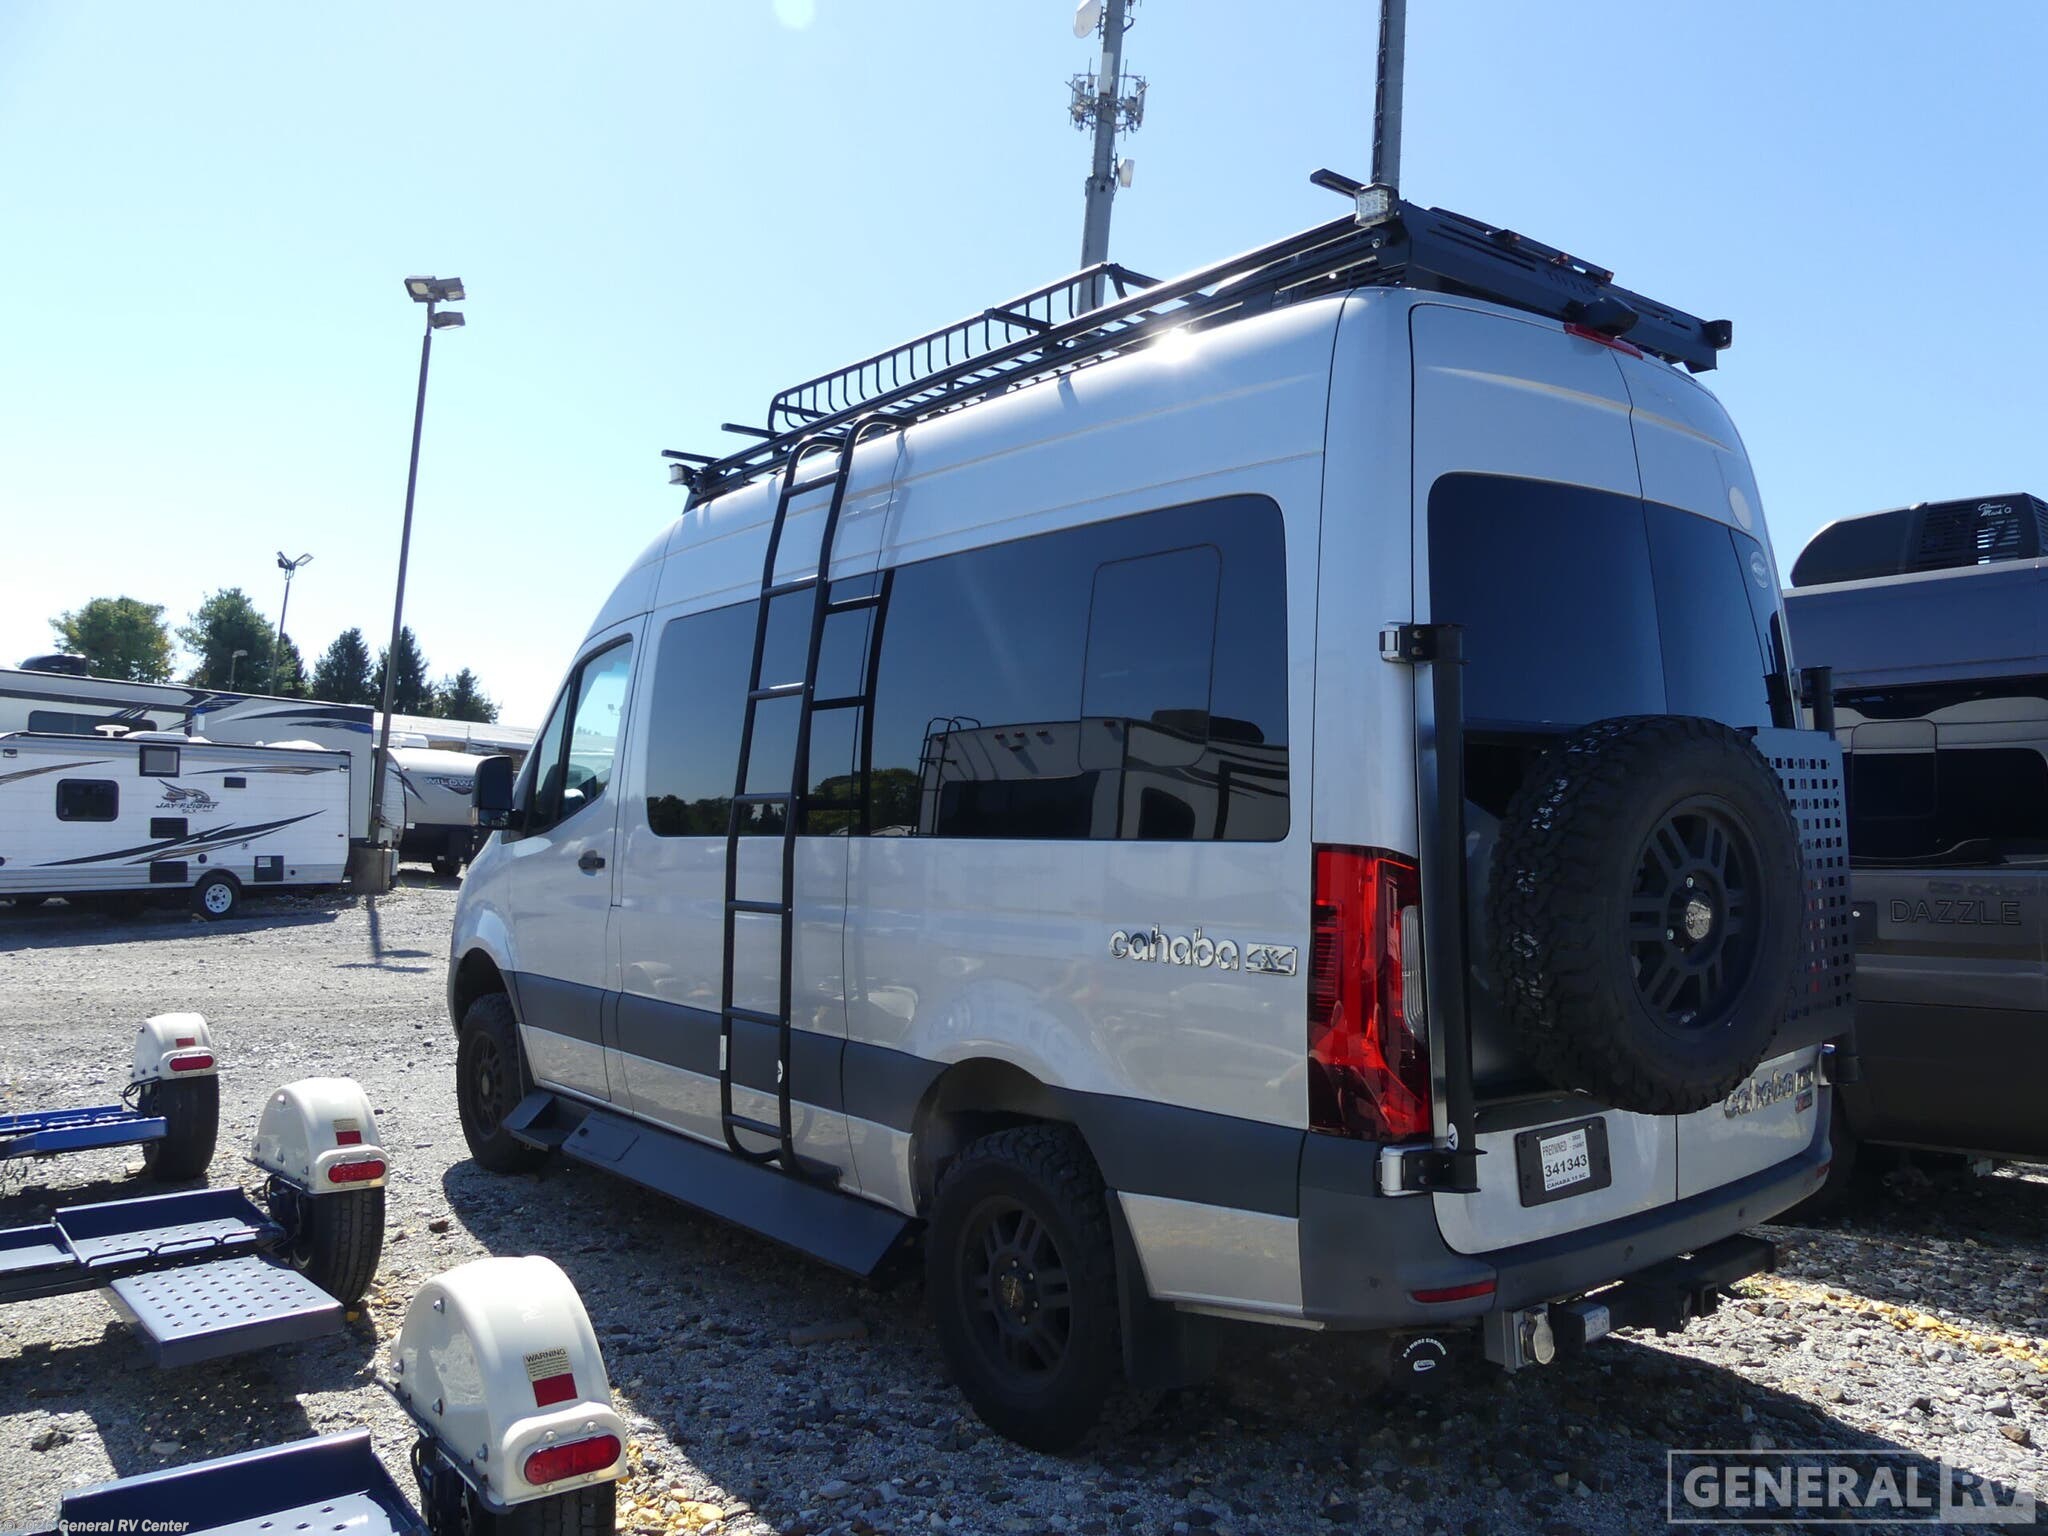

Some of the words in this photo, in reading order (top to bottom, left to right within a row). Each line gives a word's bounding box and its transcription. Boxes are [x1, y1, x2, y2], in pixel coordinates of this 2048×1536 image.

[1890, 899, 2022, 926] DAZZLE
[1109, 922, 1240, 970] cahaba
[1544, 1153, 1588, 1178] 341343
[525, 1348, 566, 1362] WARNING
